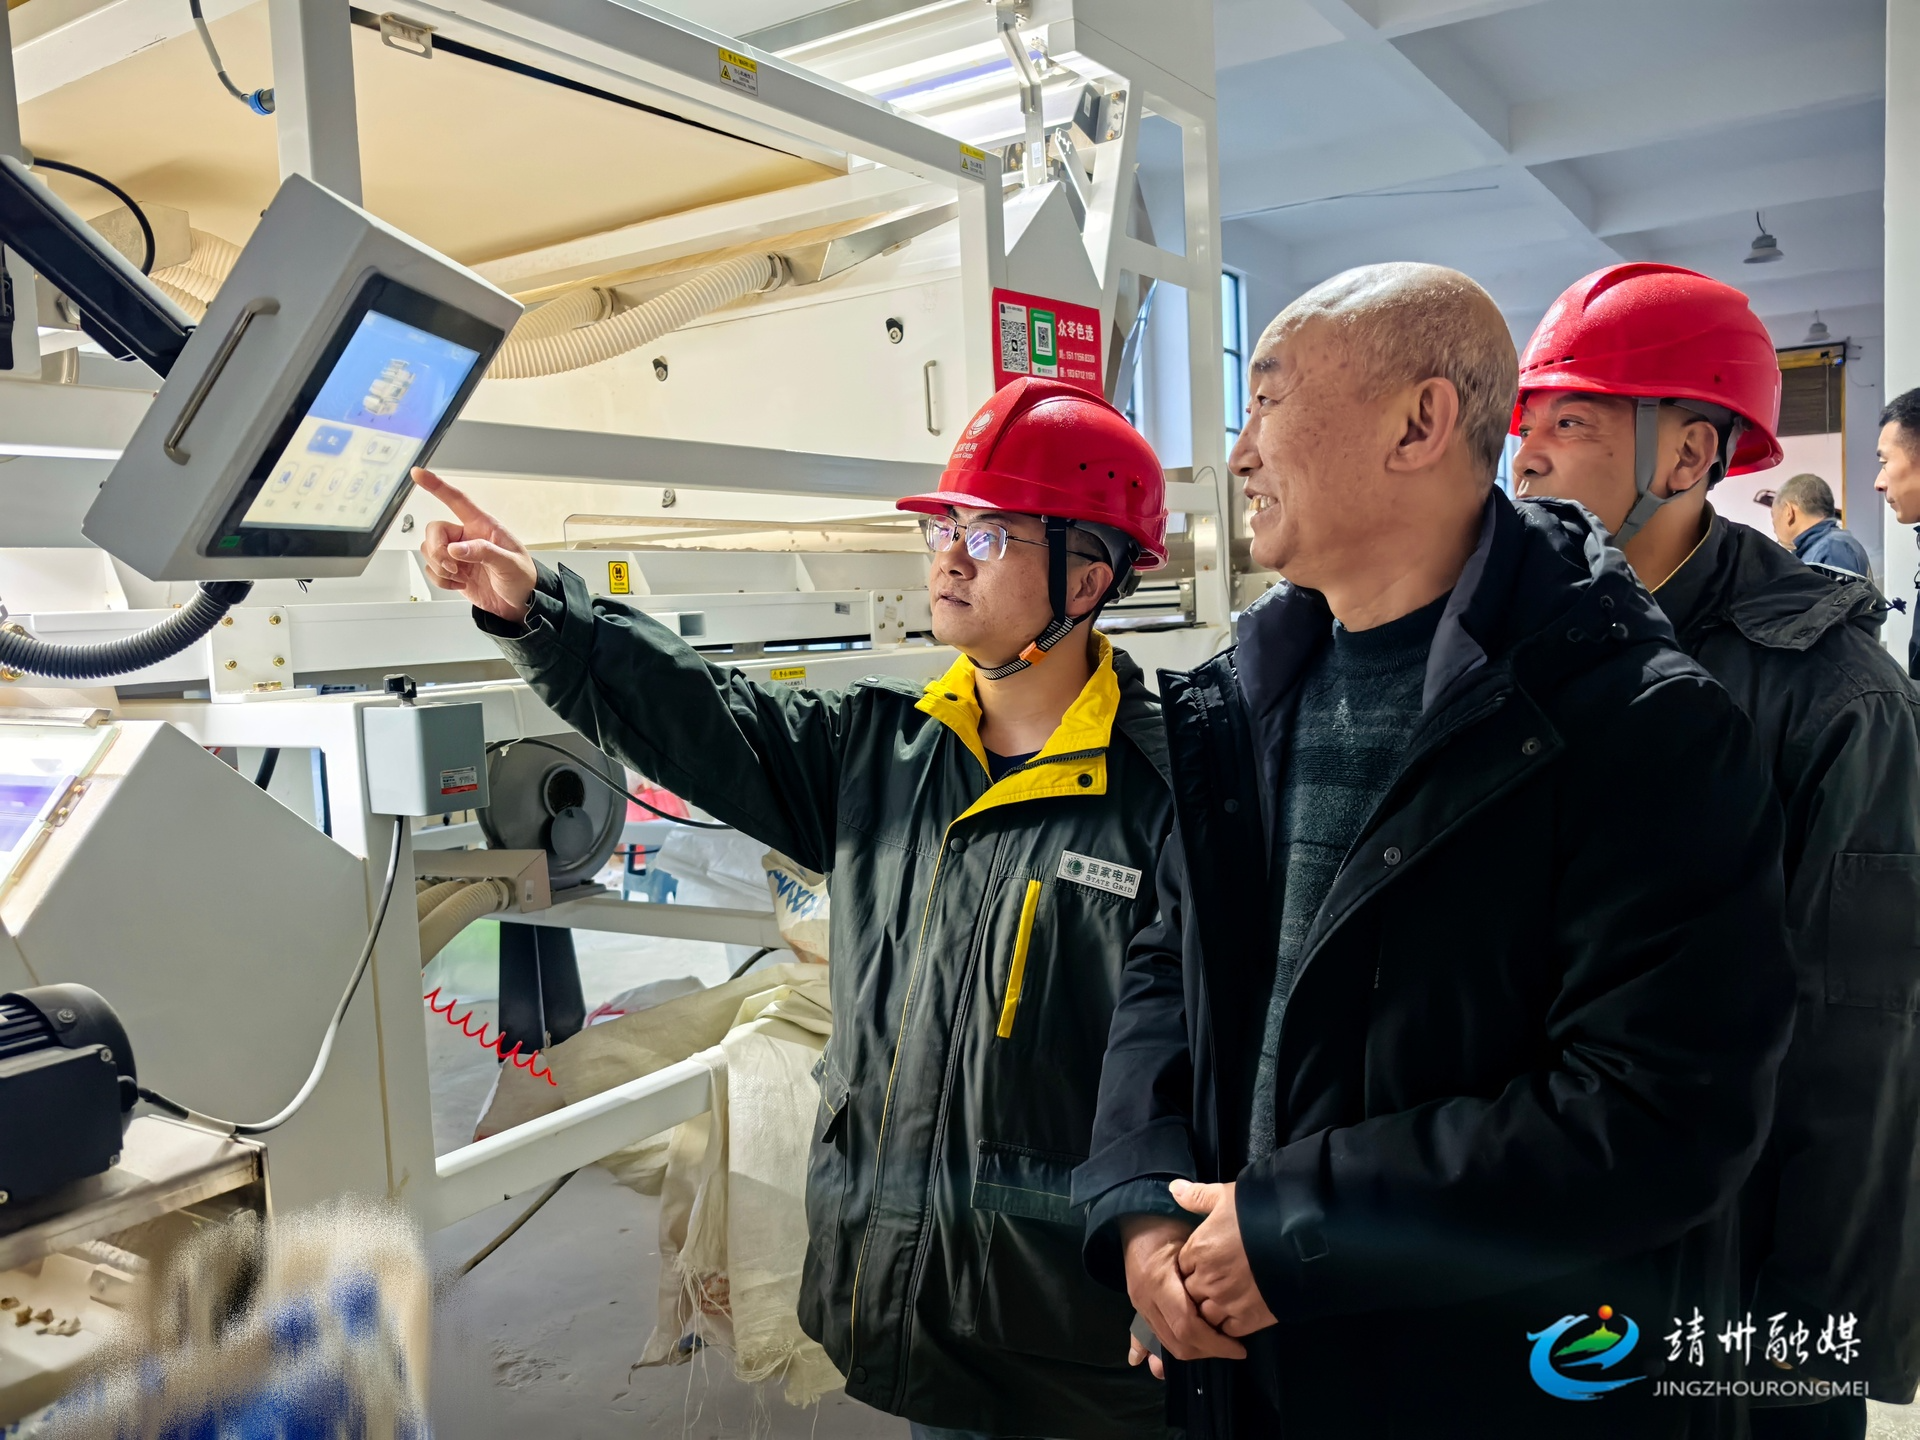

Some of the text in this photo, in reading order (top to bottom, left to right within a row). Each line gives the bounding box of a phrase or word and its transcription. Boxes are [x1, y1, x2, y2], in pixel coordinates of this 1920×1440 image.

[1057, 319, 1094, 342] 众苓色选
[1085, 875, 1133, 893] STATE GRID
[1087, 863, 1136, 885] 国家电网
